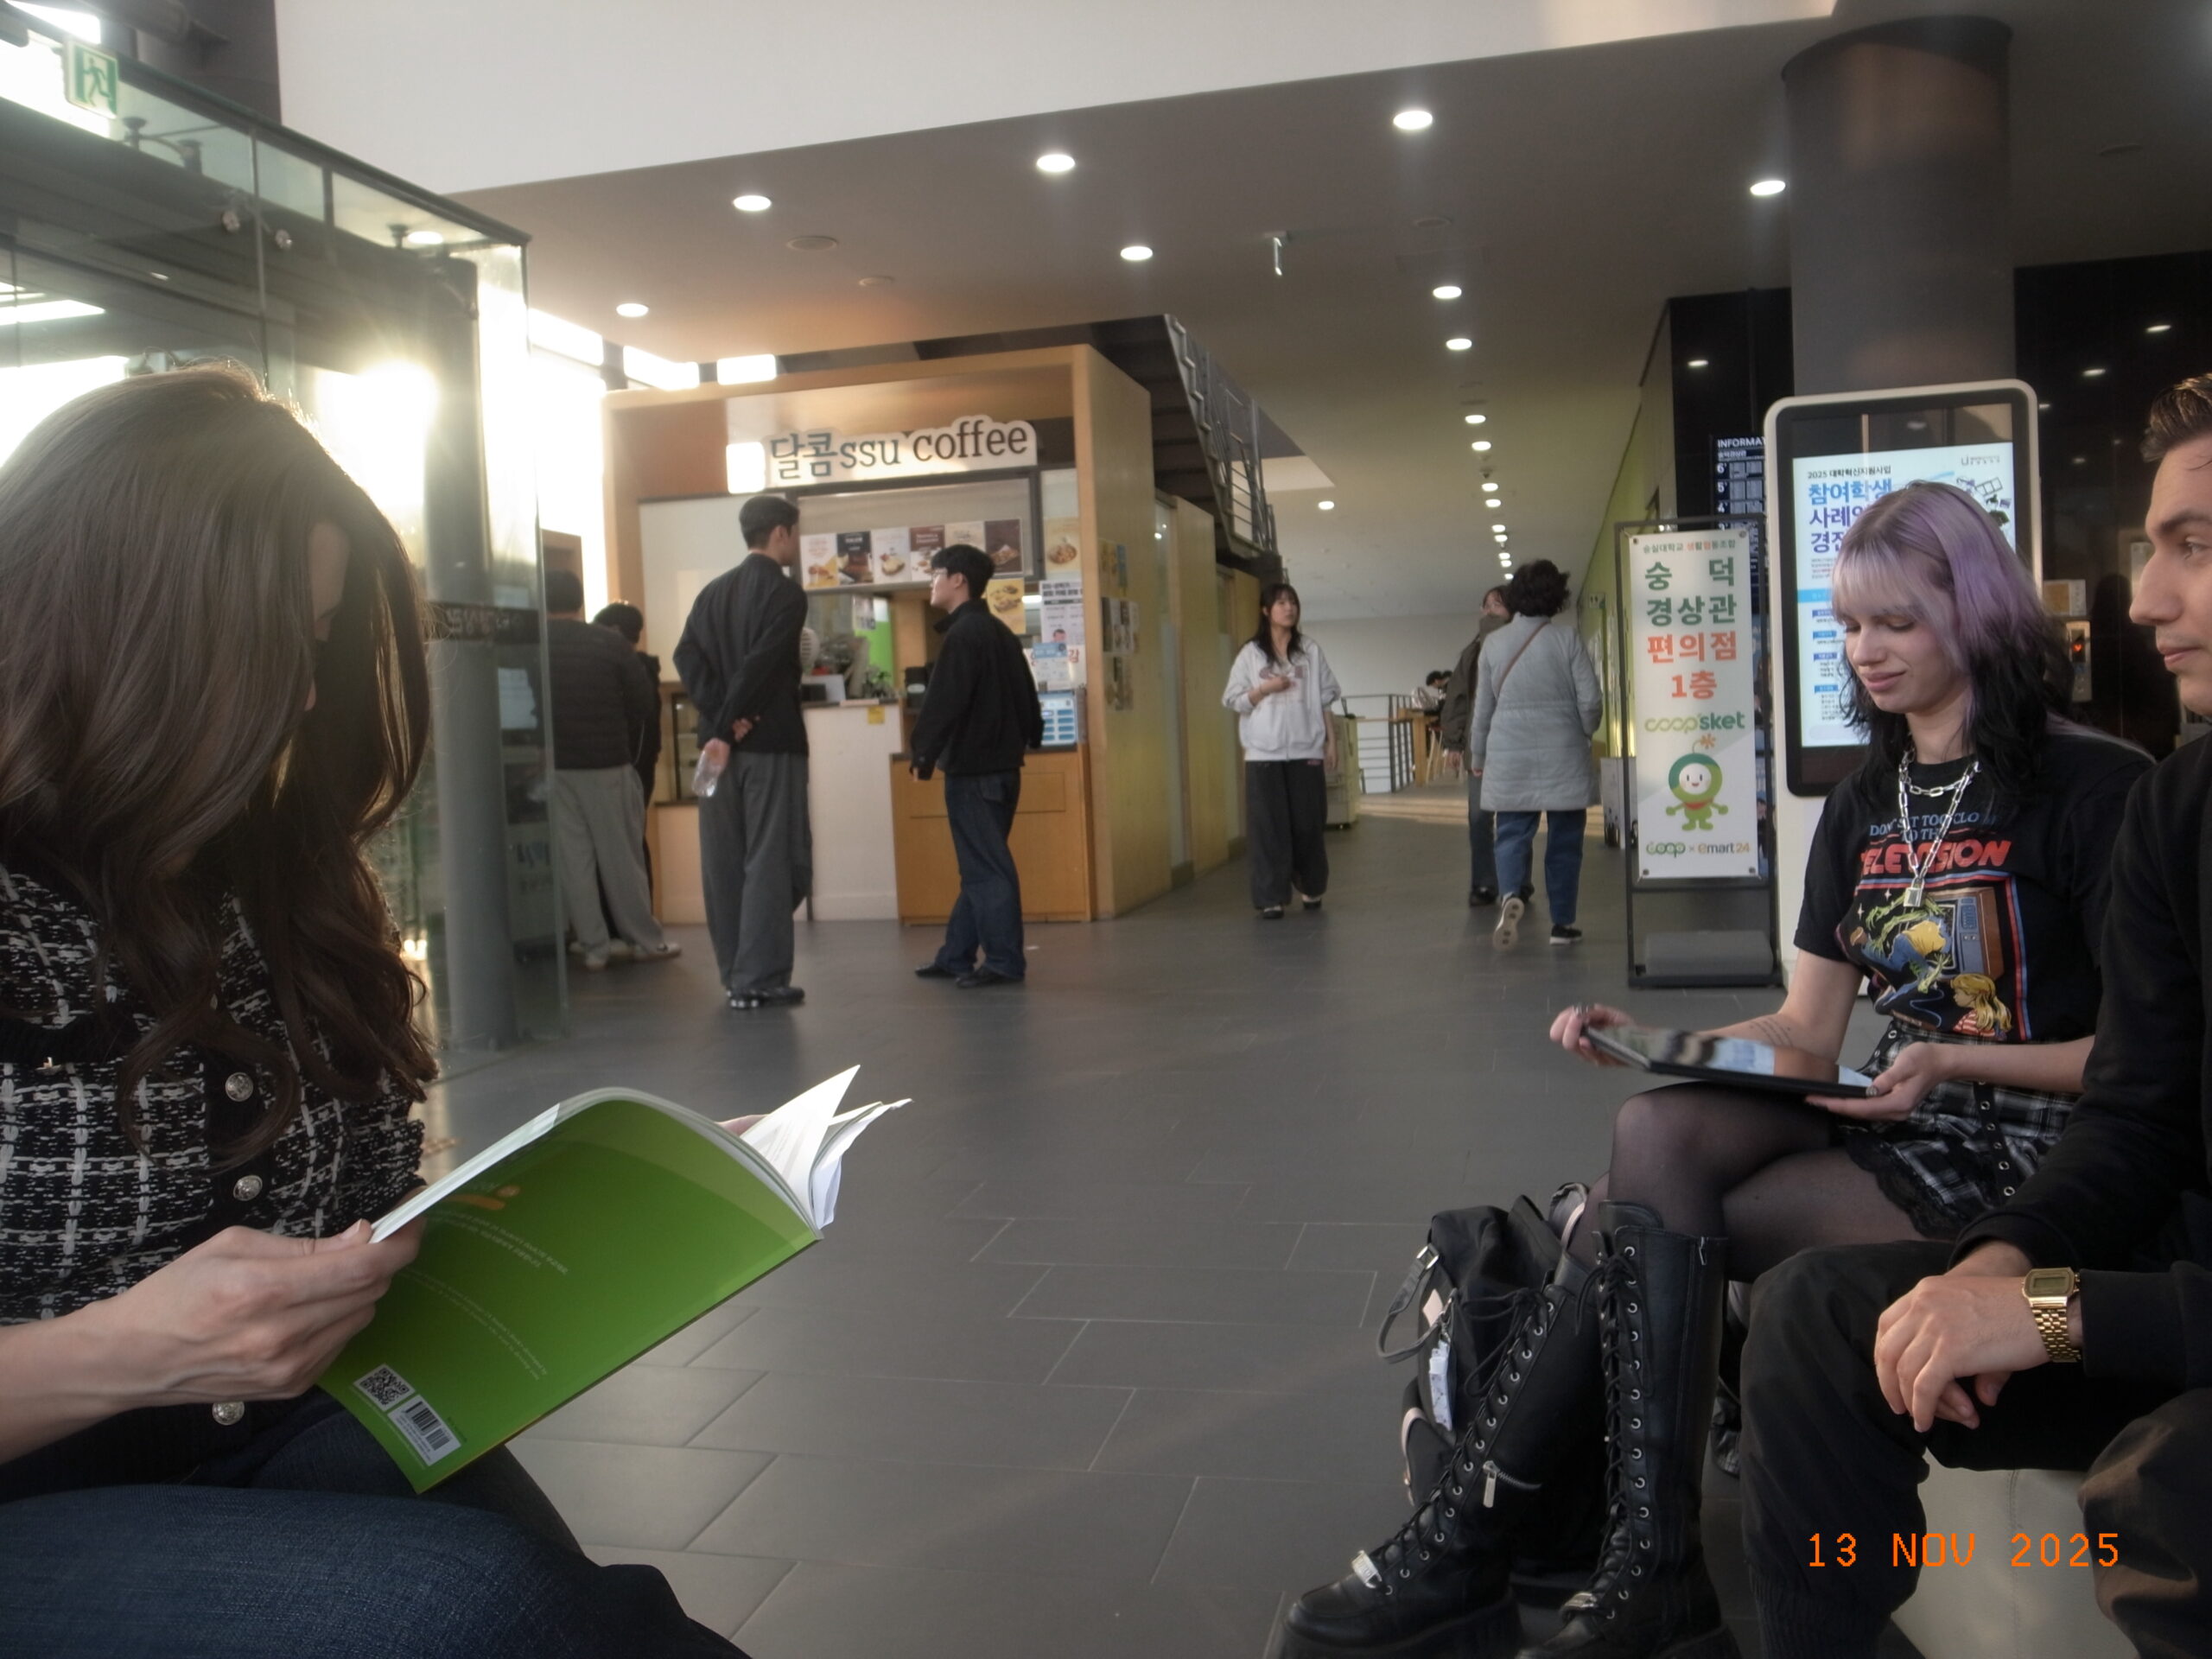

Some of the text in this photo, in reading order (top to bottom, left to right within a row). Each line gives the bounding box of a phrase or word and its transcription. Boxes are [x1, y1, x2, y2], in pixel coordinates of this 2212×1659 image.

[770, 419, 1028, 480] 달콤ssu coffee
[1808, 471, 1827, 480] 2025
[1647, 594, 1737, 626] 경상관
[1647, 631, 1737, 664] 편의점
[1672, 671, 1717, 700] 1층
[1870, 817, 1897, 836] DON'
[1897, 816, 1920, 829] ST
[1921, 828, 1942, 840] TH
